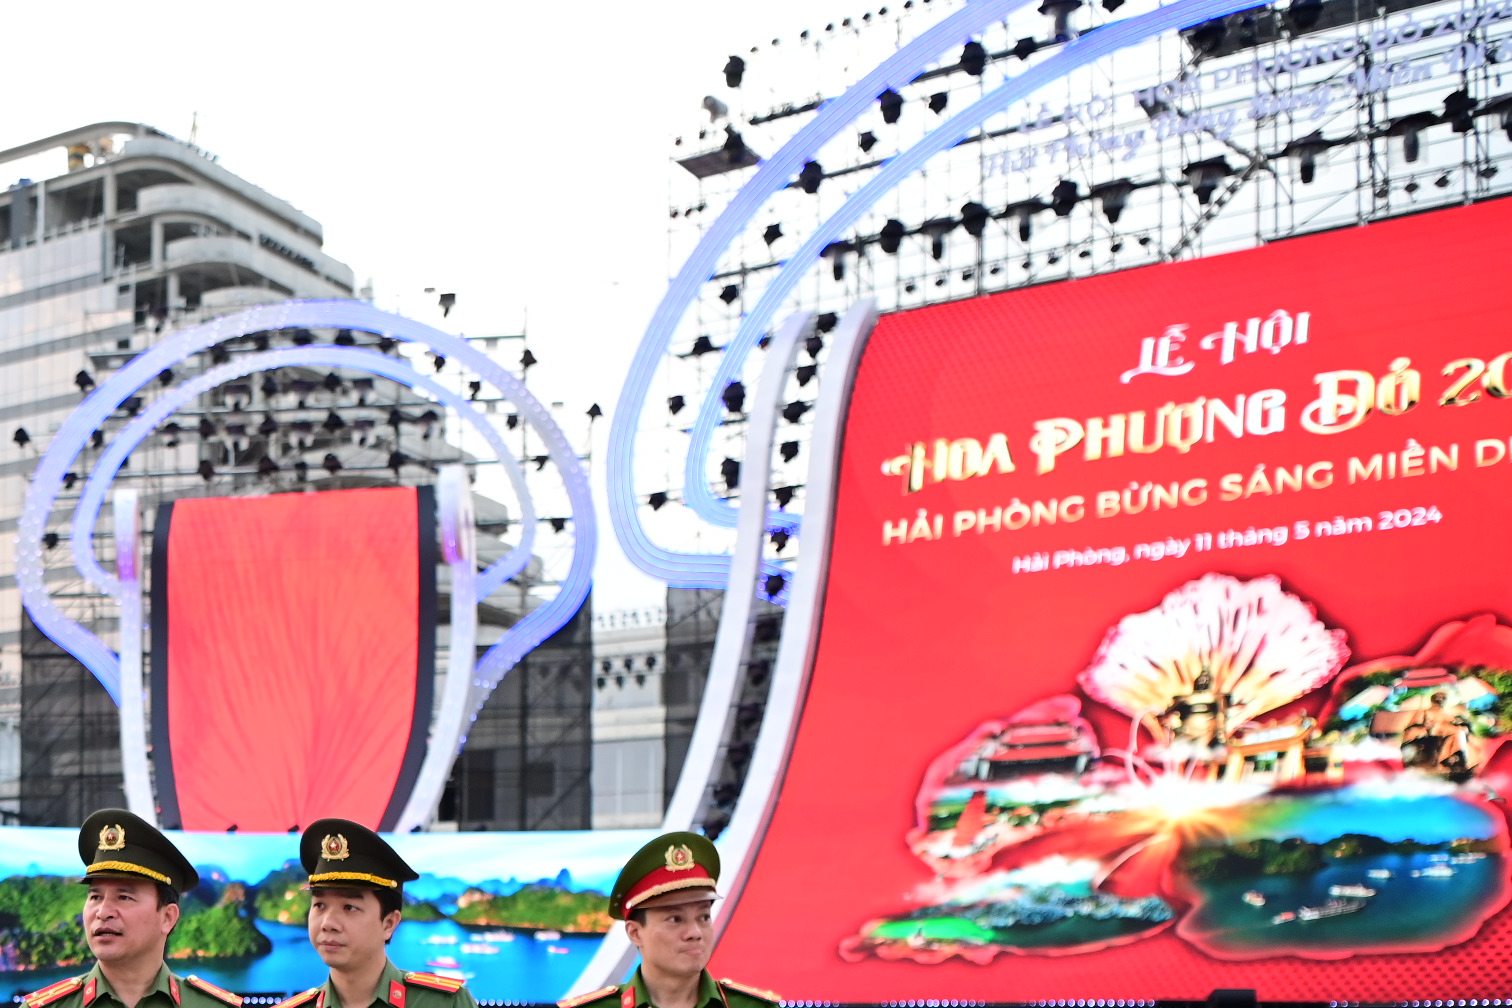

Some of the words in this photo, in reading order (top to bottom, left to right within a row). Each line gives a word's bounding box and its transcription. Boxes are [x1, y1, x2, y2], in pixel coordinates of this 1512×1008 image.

[1120, 322, 1195, 384] LỄ
[1199, 308, 1310, 366] HỘI
[881, 432, 1016, 496] HOA
[1029, 388, 1286, 476] PHƯỢNG
[1300, 356, 1421, 435] ĐỎ
[881, 508, 944, 546] HẢI
[952, 494, 1086, 538] PHÒNG
[1095, 477, 1209, 519] BỪNG
[1219, 460, 1334, 502] SÁNG
[1347, 437, 1459, 485] MIỀN
[1133, 536, 1192, 562] ngày
[1195, 532, 1213, 552] 11
[1216, 525, 1289, 550] tháng
[1315, 514, 1373, 538] năm
[1377, 504, 1444, 531] 2024
